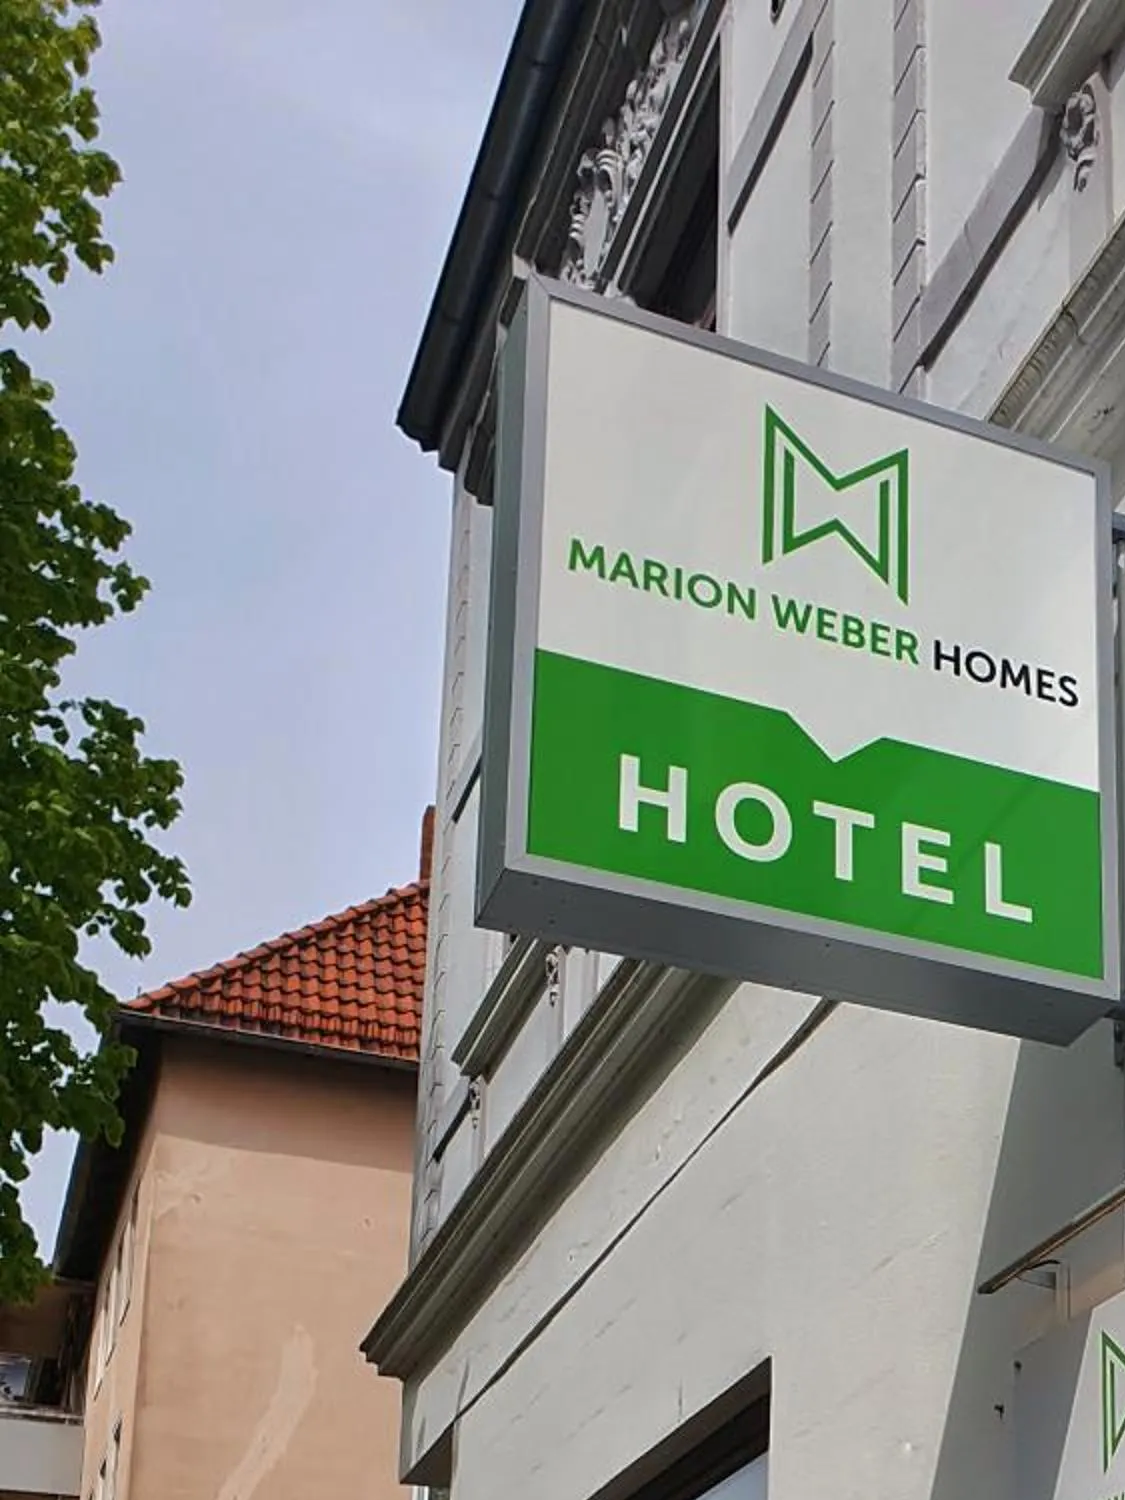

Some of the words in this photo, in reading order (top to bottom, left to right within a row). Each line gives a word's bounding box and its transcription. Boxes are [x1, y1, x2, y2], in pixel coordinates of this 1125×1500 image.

[567, 538, 757, 620] MARION
[770, 594, 919, 665] WEBER
[934, 640, 1079, 708] HOMES
[617, 752, 1033, 924] HOTEL
